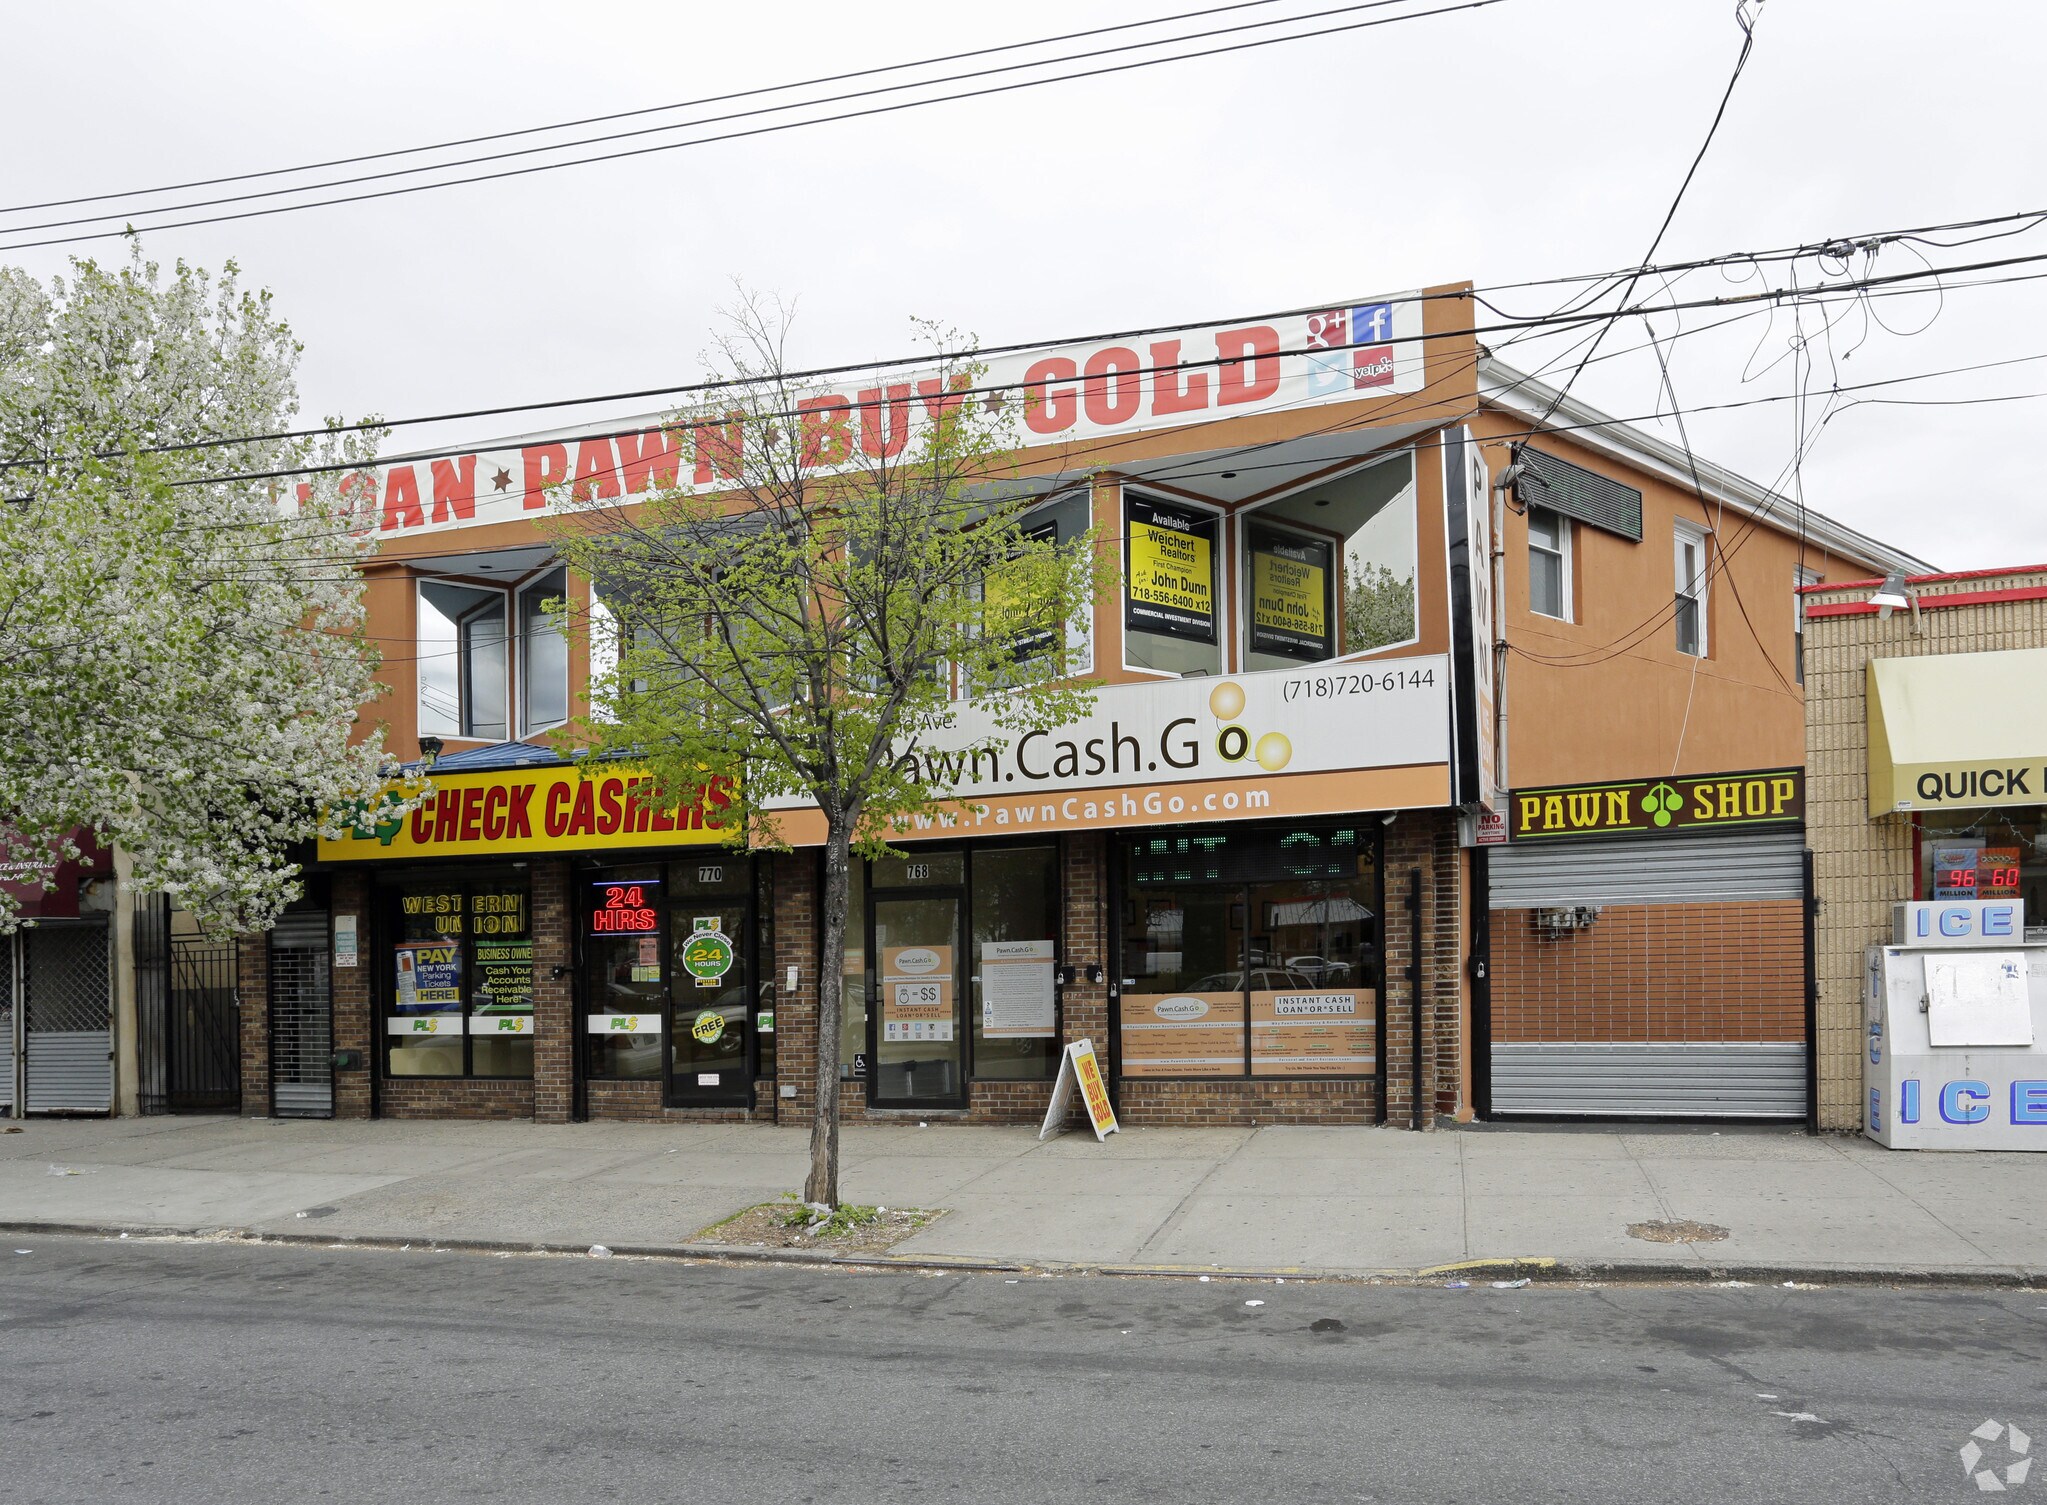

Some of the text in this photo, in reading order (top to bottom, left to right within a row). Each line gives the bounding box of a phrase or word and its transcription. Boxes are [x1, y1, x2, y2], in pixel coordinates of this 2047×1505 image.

[1355, 363, 1381, 379] yelp
[521, 410, 744, 511] PAWN
[798, 373, 972, 468] BUY
[1023, 325, 1281, 434] GOLD
[1152, 512, 1190, 531] Available
[1147, 528, 1195, 552] Weichert
[1160, 545, 1196, 563] Realtors
[1153, 560, 1193, 575] First Champion
[1151, 570, 1207, 597] John Dunn
[1132, 586, 1211, 611] 718-556-6400 x12
[1132, 607, 1211, 628] COMMERCIAL INVESTMENT DIVISION
[1283, 667, 1435, 703] (718)720-6144
[920, 713, 957, 732] Ave.
[880, 717, 1249, 787] awn.Cash.Go
[1916, 767, 2032, 802] QUICK
[411, 784, 536, 844] CHECK
[890, 789, 1270, 832] www.PawnCashGo.com
[1519, 778, 1795, 831] PAWN SHOP
[1481, 815, 1501, 824] NO
[699, 867, 722, 882] 770
[907, 864, 929, 879] 768
[1950, 867, 2019, 887] 96 60
[402, 894, 519, 914] WESTERN
[605, 886, 643, 908] 24
[435, 915, 519, 934] UNION
[594, 908, 656, 931] HRS
[694, 917, 719, 931] PL$
[1916, 906, 2014, 937] ICE
[684, 932, 731, 947] We Never Close
[416, 948, 457, 965] PAY
[477, 947, 533, 960] BUSINESS OWNE
[692, 948, 723, 961] 24
[417, 963, 457, 972] NEW YORK
[422, 972, 451, 981] Parking
[485, 966, 532, 975] Cash Your
[424, 979, 451, 988] Tickets
[481, 985, 532, 994] Receivable
[487, 976, 531, 985] Accounts
[420, 989, 456, 1001] HERE!
[496, 995, 522, 1003] Here!
[1278, 996, 1351, 1005] INSTANT CASH
[413, 1018, 438, 1033] PL$
[498, 1017, 524, 1033] PL$
[610, 1016, 638, 1032] PL$
[694, 1017, 723, 1038] FREE
[1081, 1060, 1096, 1081] WE
[1086, 1080, 1103, 1103] BUY
[1092, 1099, 1112, 1124] GOLD
[1901, 1079, 2047, 1125] ICE
